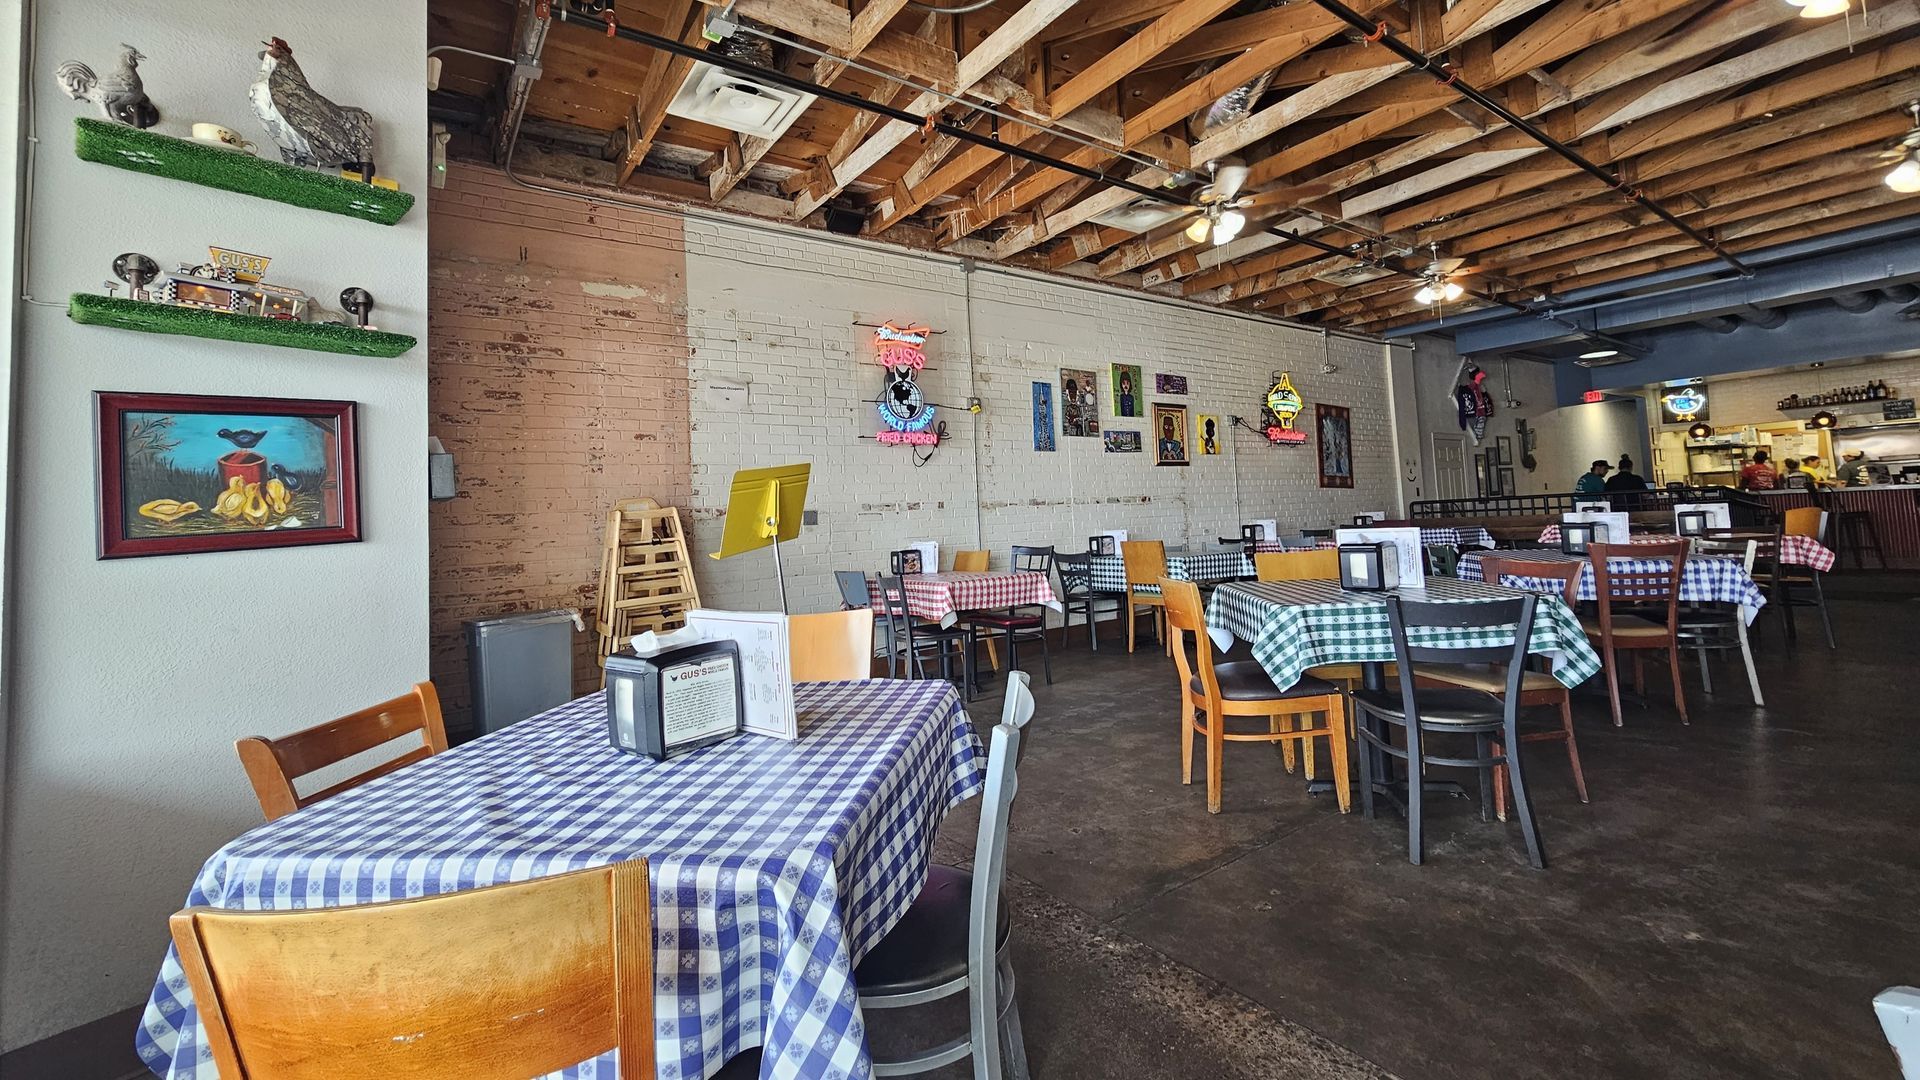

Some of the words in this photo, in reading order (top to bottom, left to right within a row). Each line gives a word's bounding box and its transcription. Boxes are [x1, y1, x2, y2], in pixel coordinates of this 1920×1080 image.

[218, 252, 263, 271] GUS'S
[878, 327, 926, 344] Budweiser
[878, 403, 904, 431] WORLD
[907, 405, 935, 432] FAMOUS
[877, 431, 900, 443] FRIED
[903, 432, 937, 444] CHICKEN
[680, 667, 708, 680] GUS'S
